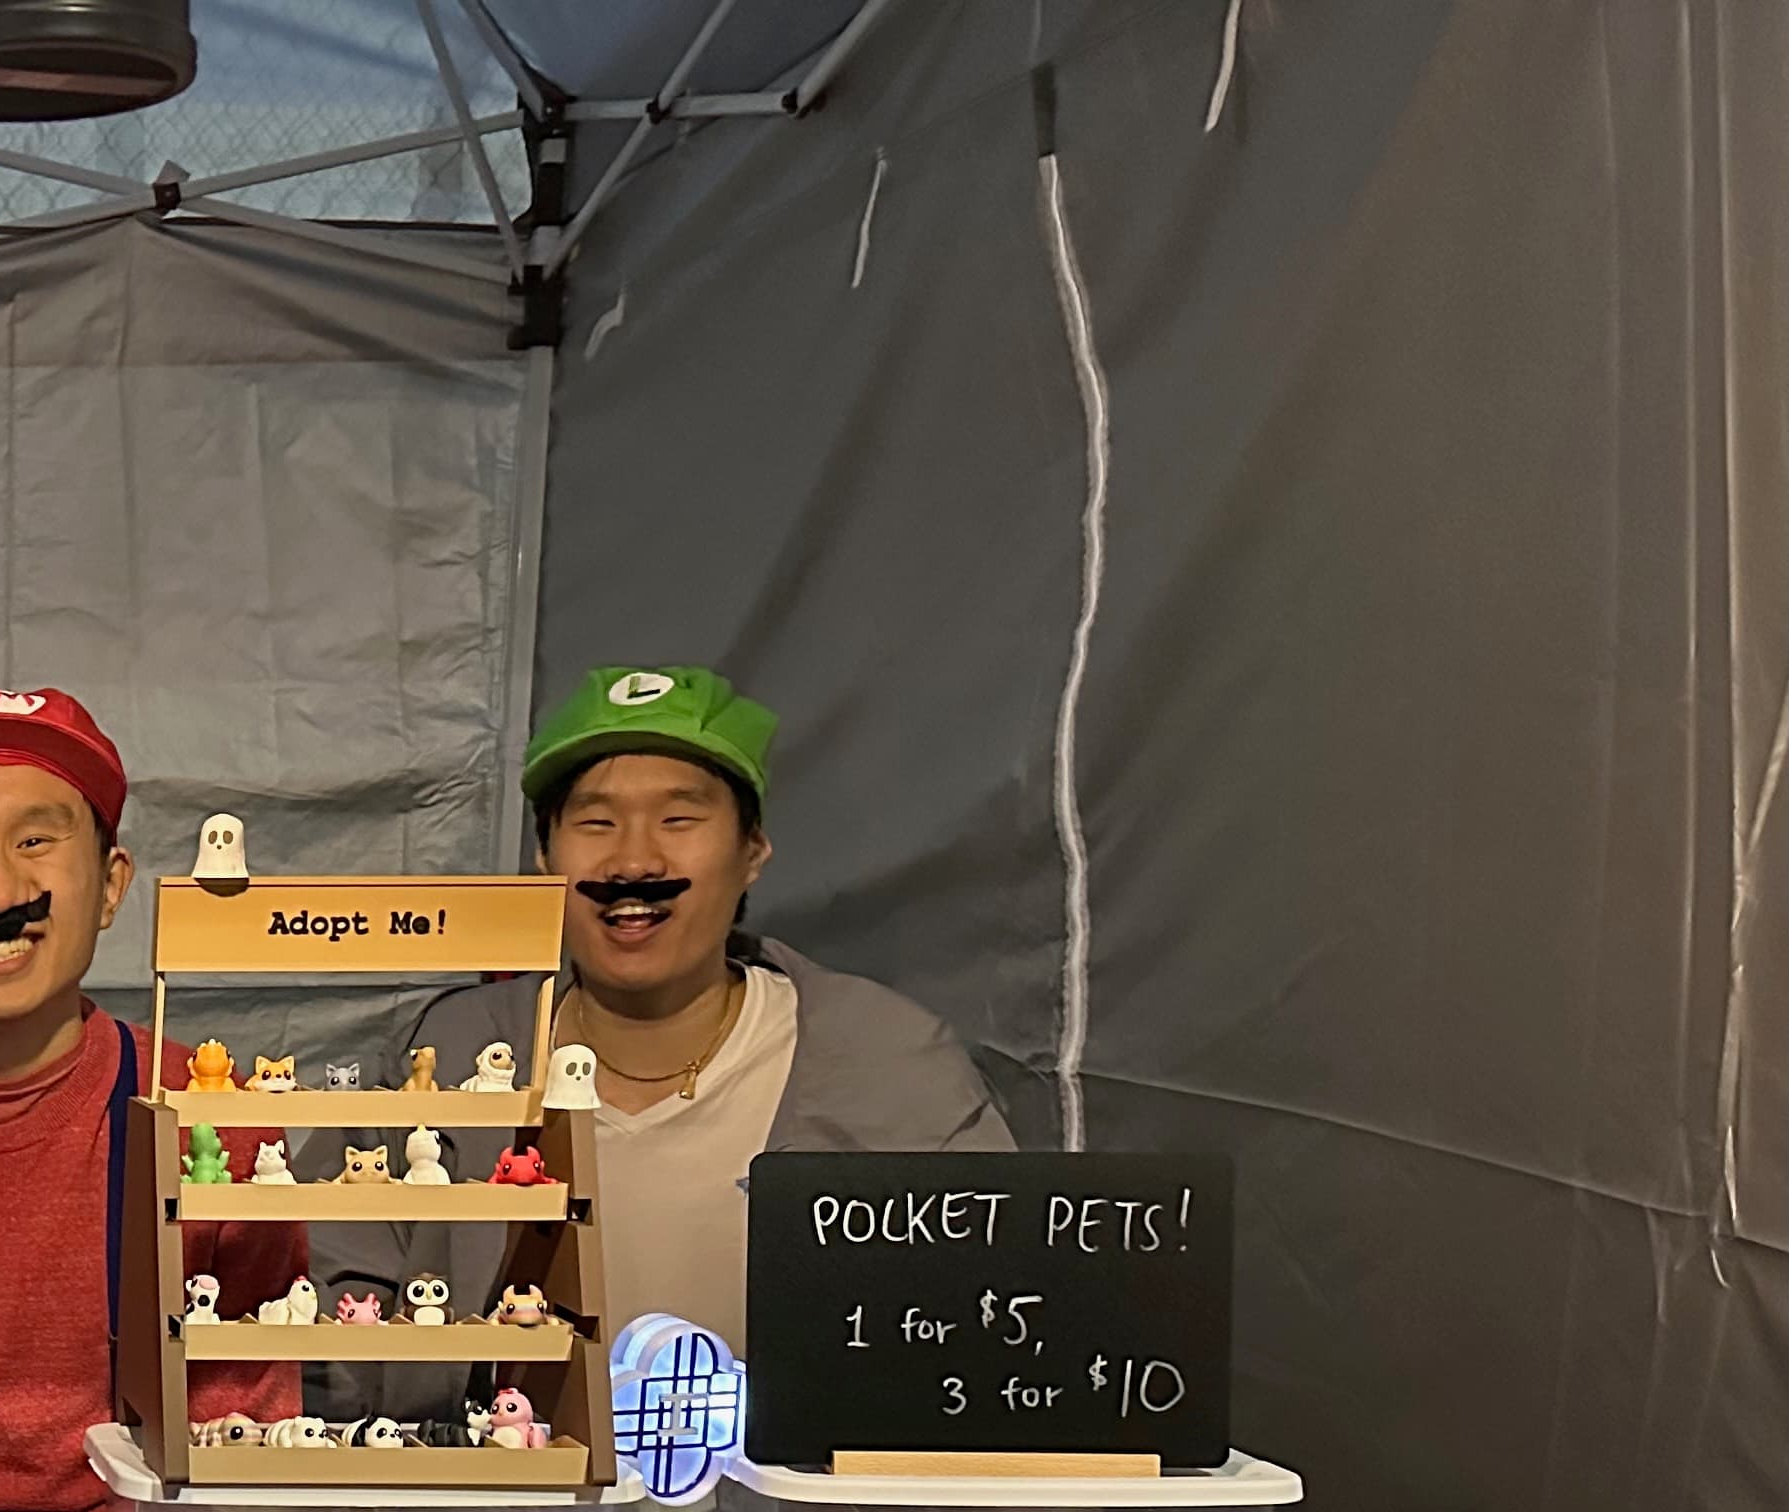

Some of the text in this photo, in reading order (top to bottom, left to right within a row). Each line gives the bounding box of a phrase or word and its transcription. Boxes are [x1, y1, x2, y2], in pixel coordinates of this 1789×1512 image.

[626, 675, 661, 699] L
[267, 909, 446, 942] Adopt Me!
[812, 1187, 1191, 1253] POCKET PETS!
[845, 1289, 1044, 1356] 1 for $5,
[942, 1354, 1186, 1418] 3 for $10
